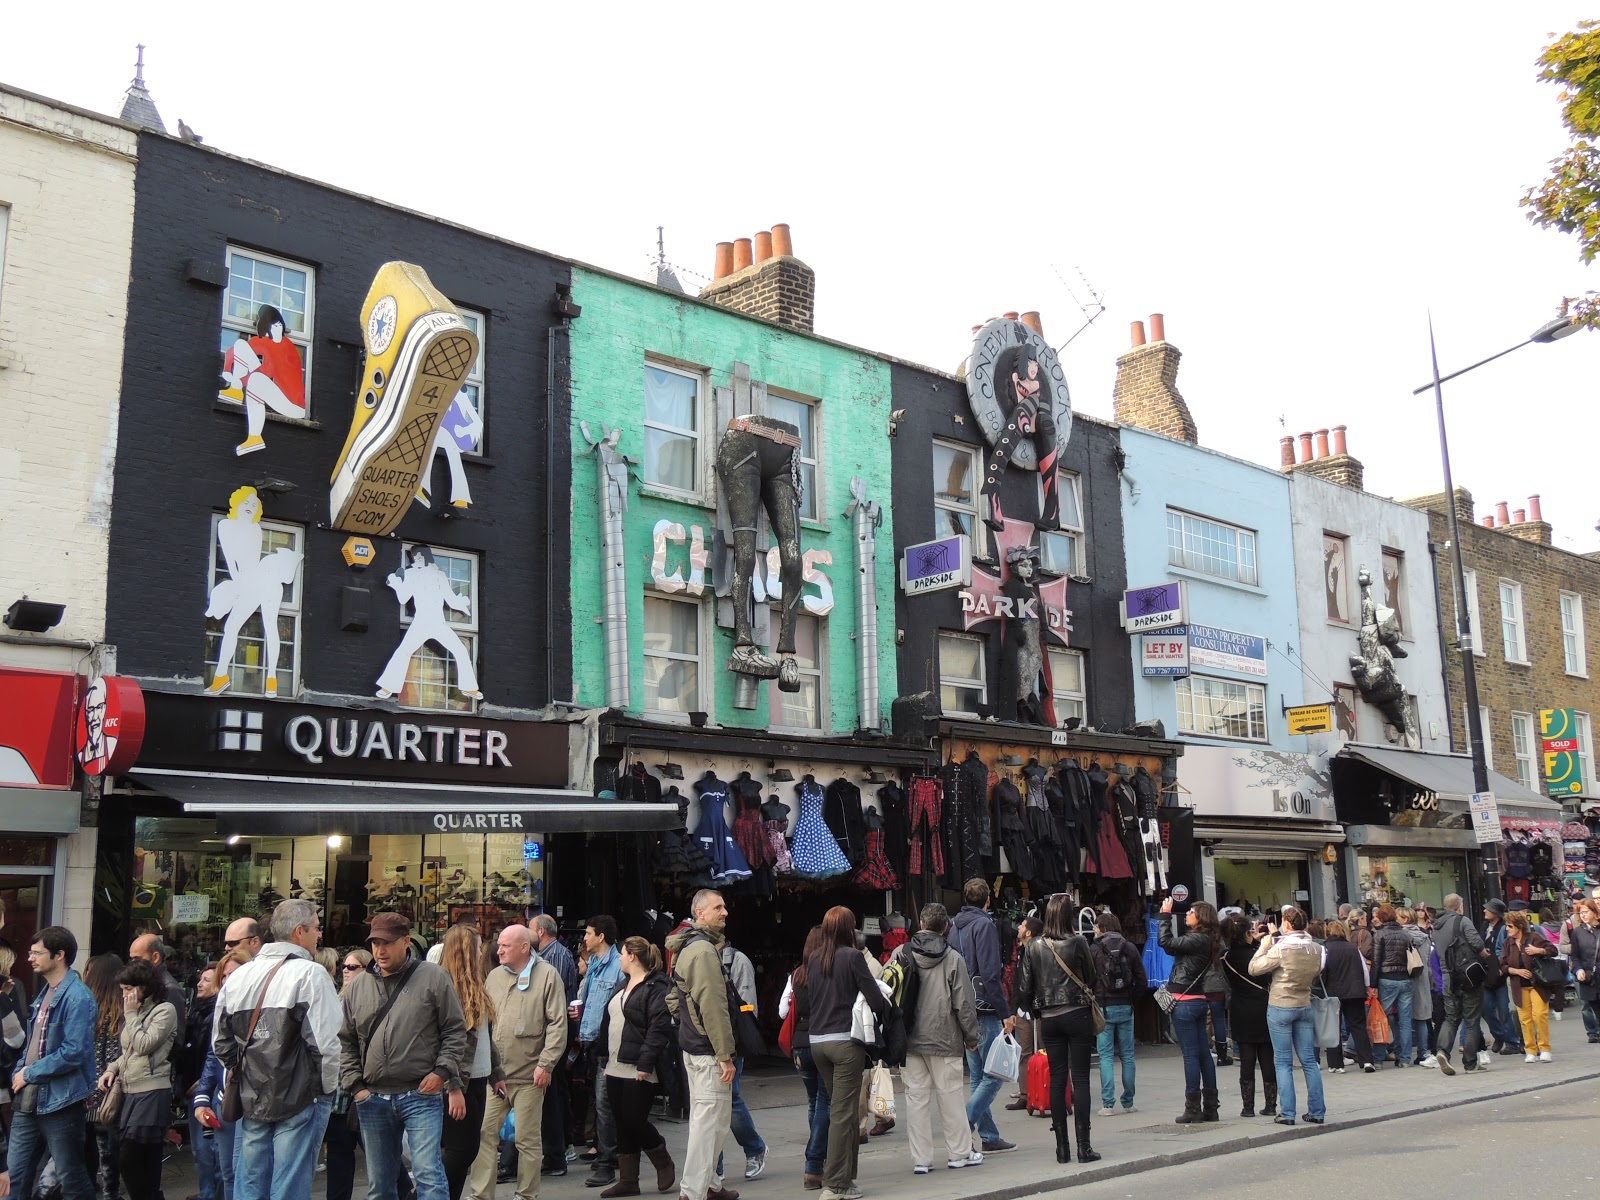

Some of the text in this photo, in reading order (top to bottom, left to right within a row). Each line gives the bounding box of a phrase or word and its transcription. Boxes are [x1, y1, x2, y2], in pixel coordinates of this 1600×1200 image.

[431, 317, 449, 328] ALL
[975, 324, 1008, 399] NEW
[423, 386, 439, 403] 4
[1020, 444, 1030, 461] &
[362, 466, 418, 489] QUARTER
[359, 489, 401, 508] SHOES
[354, 545, 368, 557] ADT
[914, 571, 954, 590] DARKSIDE
[958, 590, 1074, 632] DARKDE
[1134, 613, 1174, 628] DARKSIDE
[1190, 625, 1257, 647] AMDEN PROPERTY
[1146, 643, 1165, 653] LET
[1169, 643, 1183, 653] BY
[1195, 636, 1248, 656] CONSULTANCY
[105, 718, 118, 727] KFC
[285, 715, 513, 767] QUARTER
[1272, 789, 1311, 814] Is On
[433, 813, 523, 831] QUARTER
